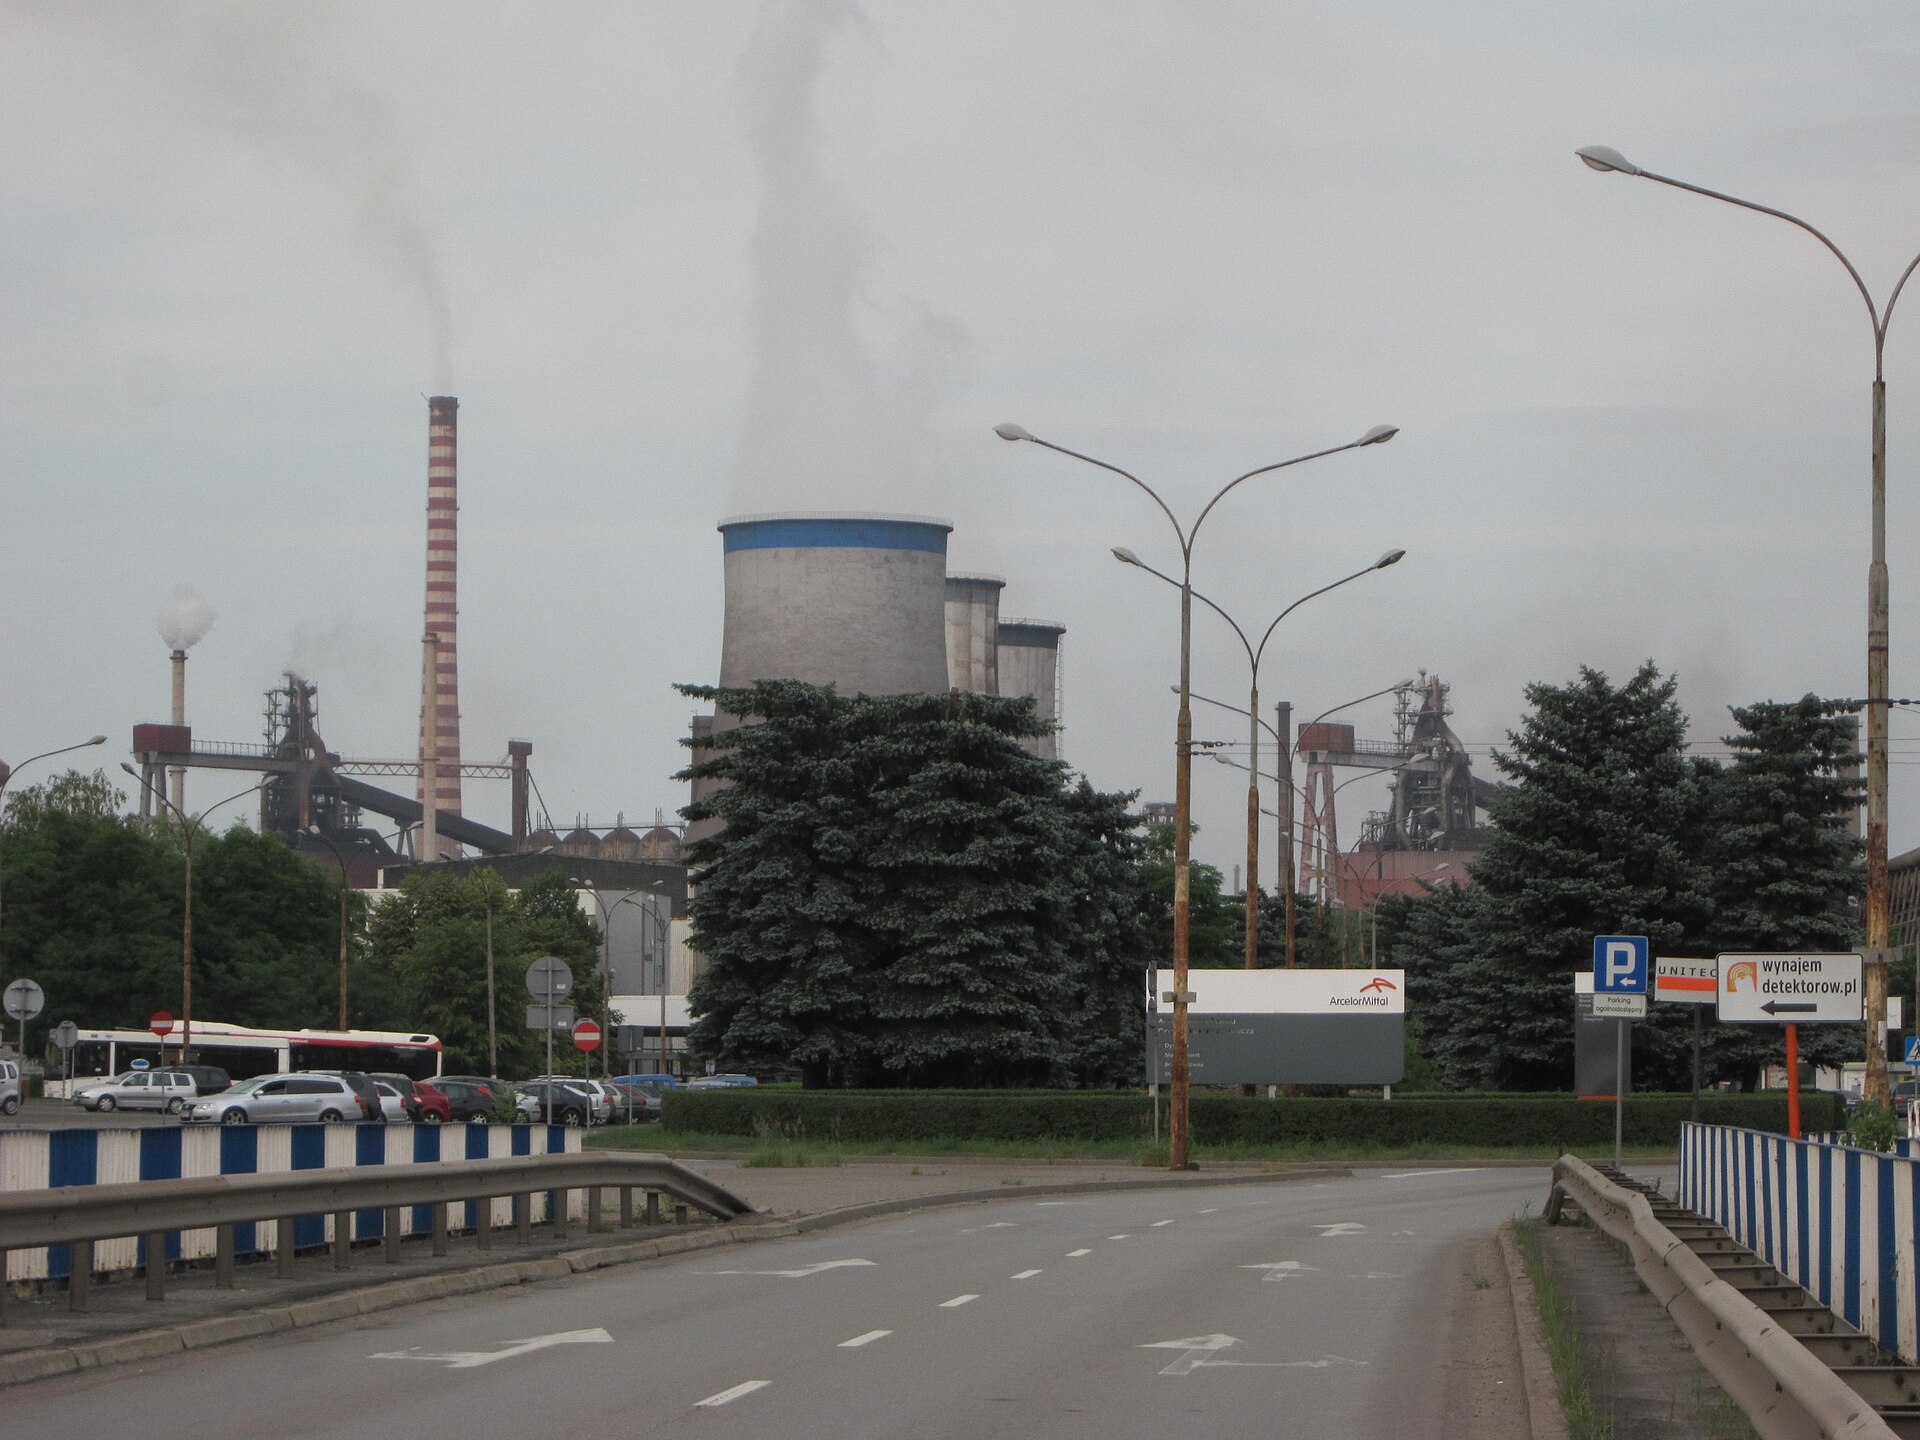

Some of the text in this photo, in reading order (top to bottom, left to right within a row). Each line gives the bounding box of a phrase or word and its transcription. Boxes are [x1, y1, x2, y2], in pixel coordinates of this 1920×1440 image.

[1606, 941, 1636, 987] P
[1762, 957, 1822, 976] wynajem
[1762, 979, 1856, 996] detektorow.pl
[1329, 996, 1389, 1006] ArcelorMittal
[1607, 996, 1631, 1004] Parking
